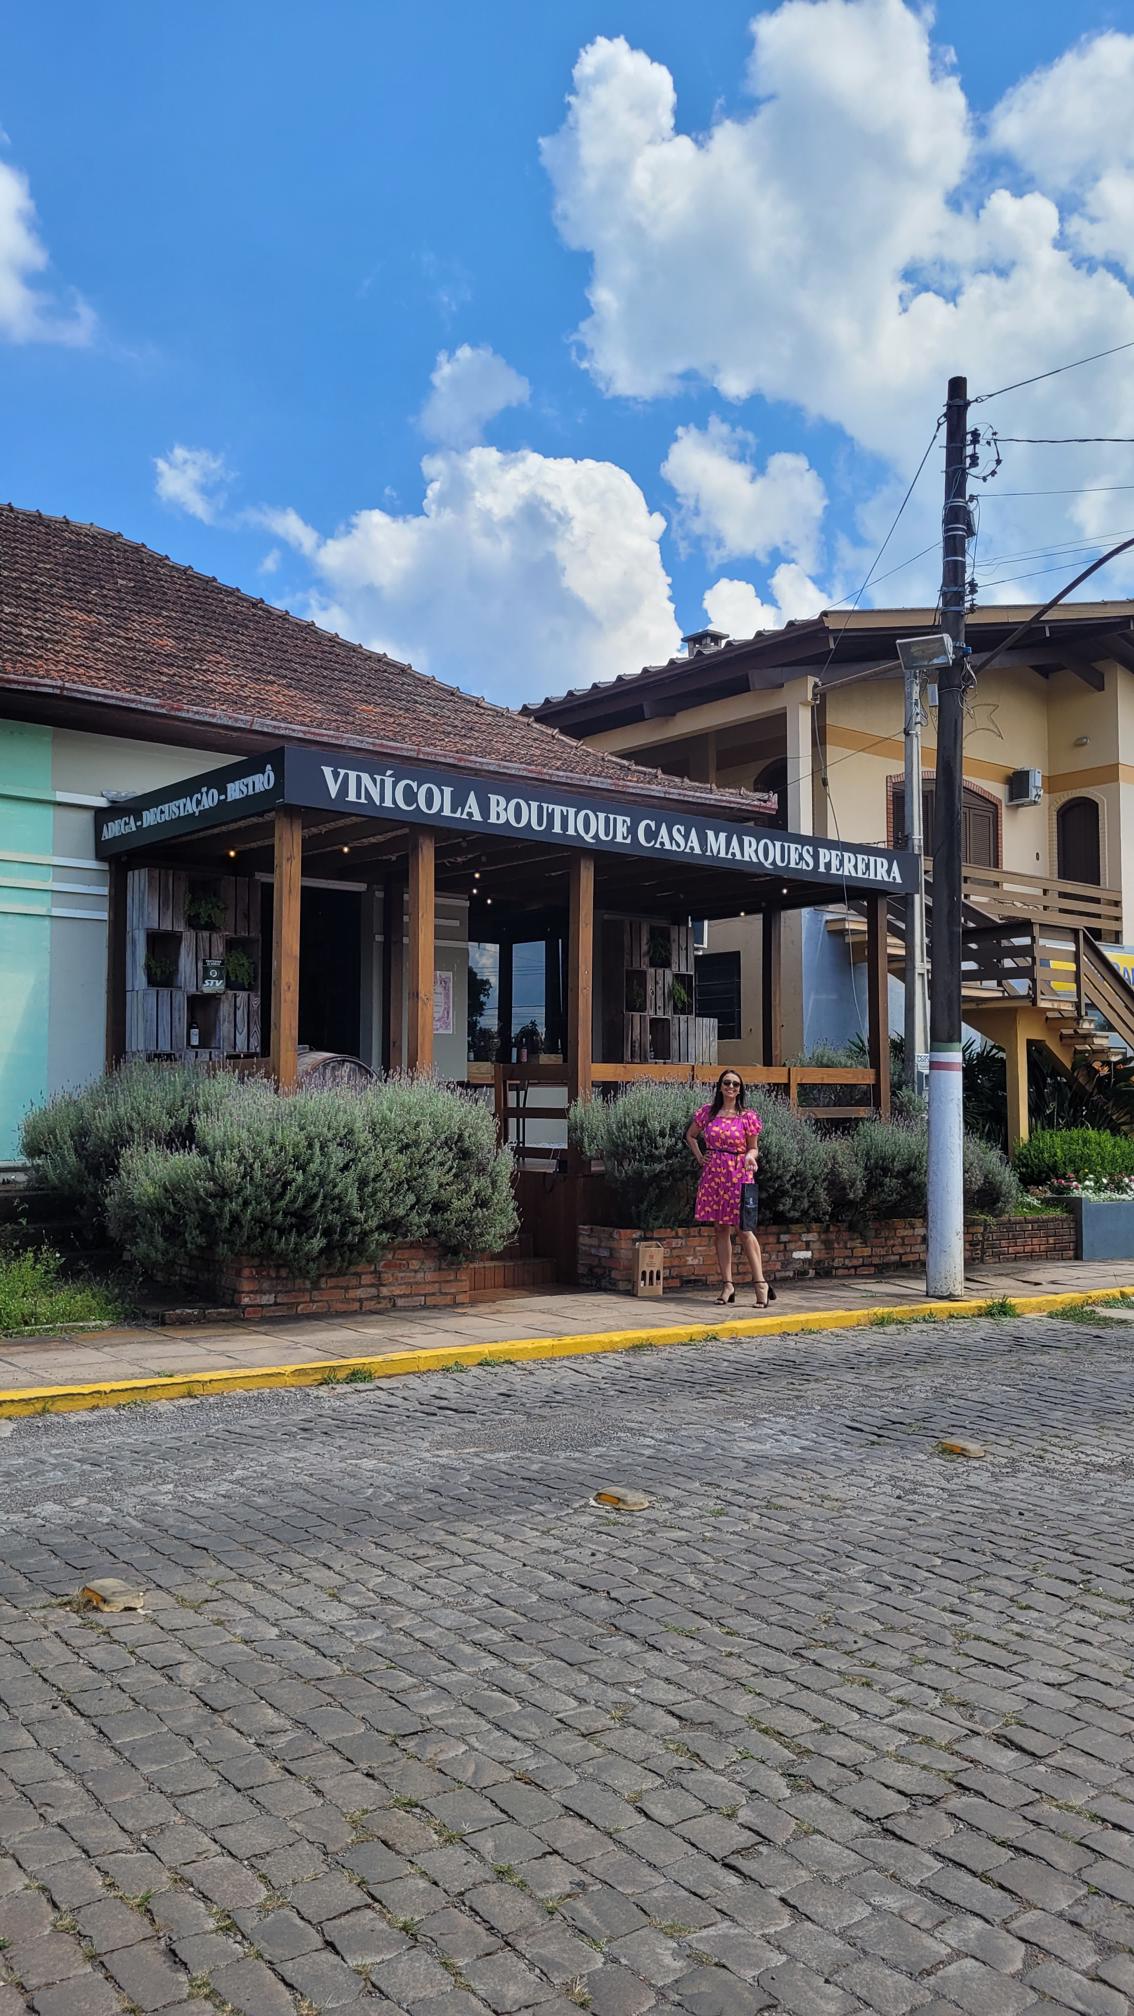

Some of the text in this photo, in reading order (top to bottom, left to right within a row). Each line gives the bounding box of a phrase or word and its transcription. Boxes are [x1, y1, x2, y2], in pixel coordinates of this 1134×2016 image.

[101, 815, 136, 841] ADEGA
[142, 786, 219, 828] DEGUSTAÇÃO
[226, 764, 275, 802] BISTRÔ
[320, 765, 902, 883] VINÍCOLA BOUTIQUE CASA MARQUES PEREIRA
[203, 979, 224, 987] STV
